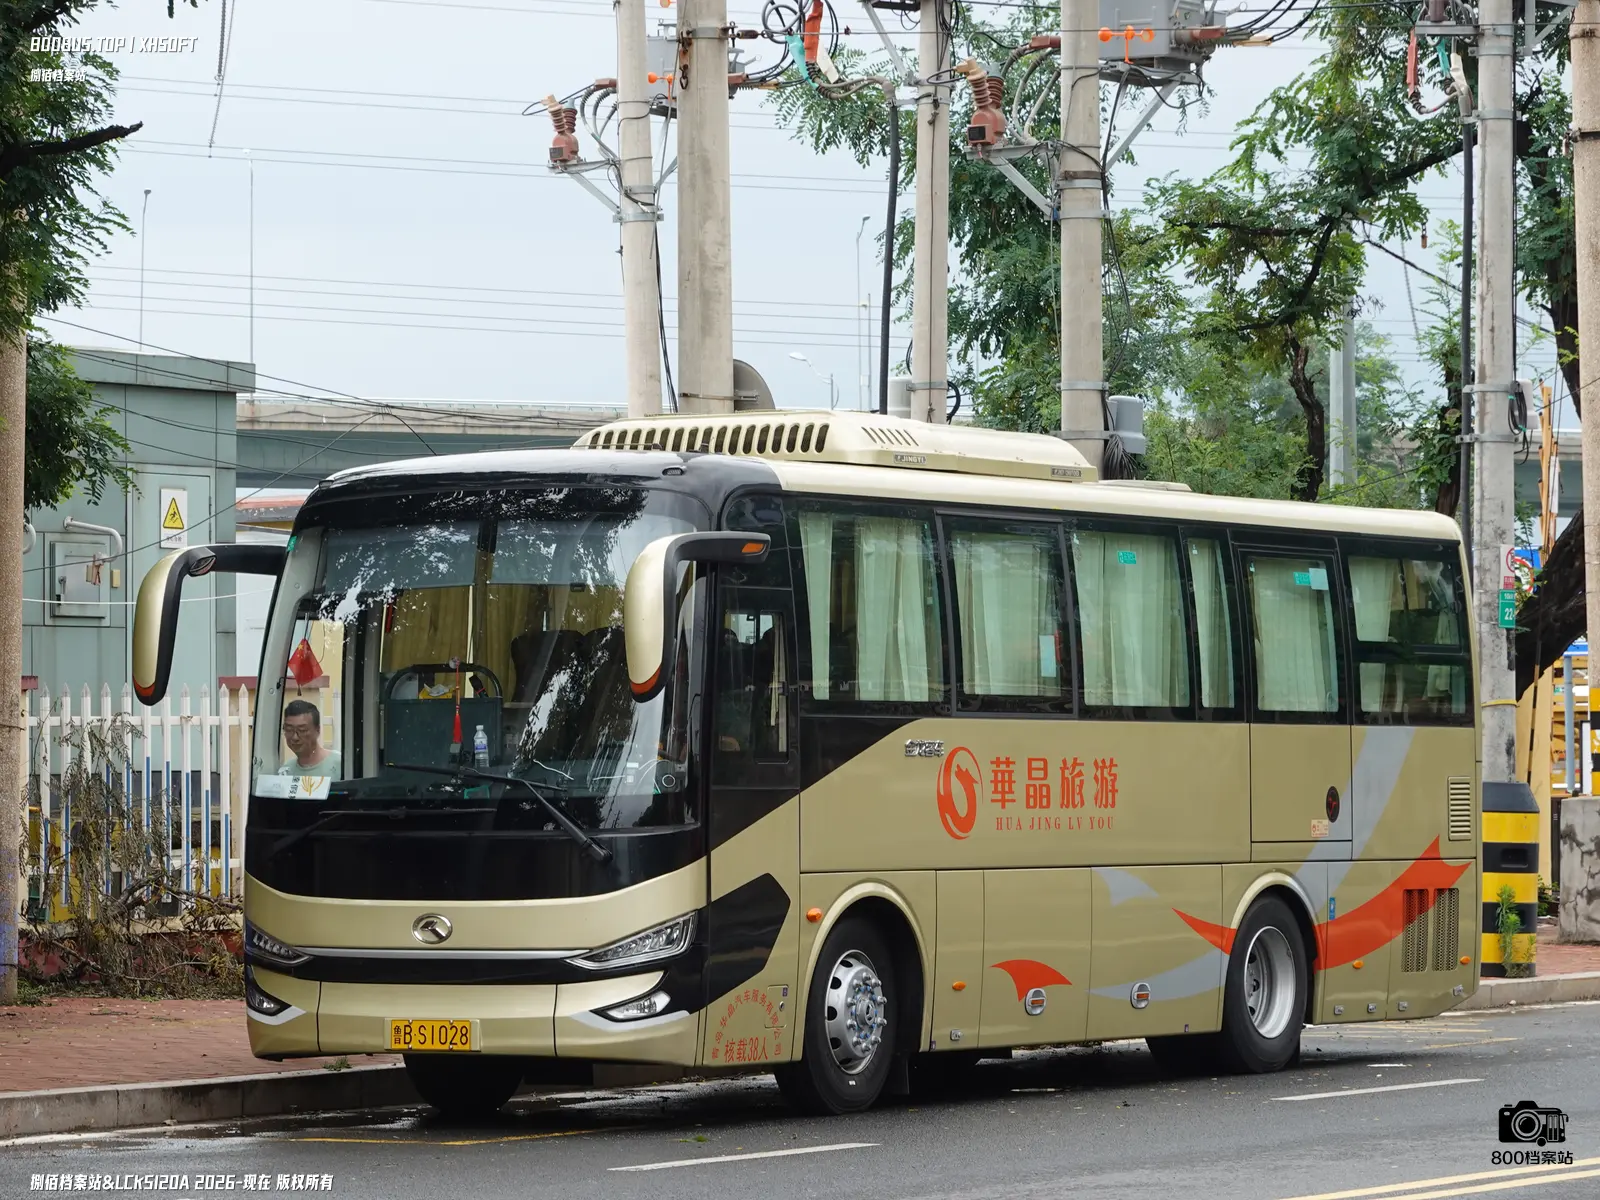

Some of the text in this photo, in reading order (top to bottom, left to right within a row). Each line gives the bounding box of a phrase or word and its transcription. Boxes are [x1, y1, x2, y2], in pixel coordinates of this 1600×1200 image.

[990, 756, 1119, 810] 華晶旅游
[996, 816, 1115, 831] HUA JING LV YOU
[724, 1036, 769, 1063] 核载38人
